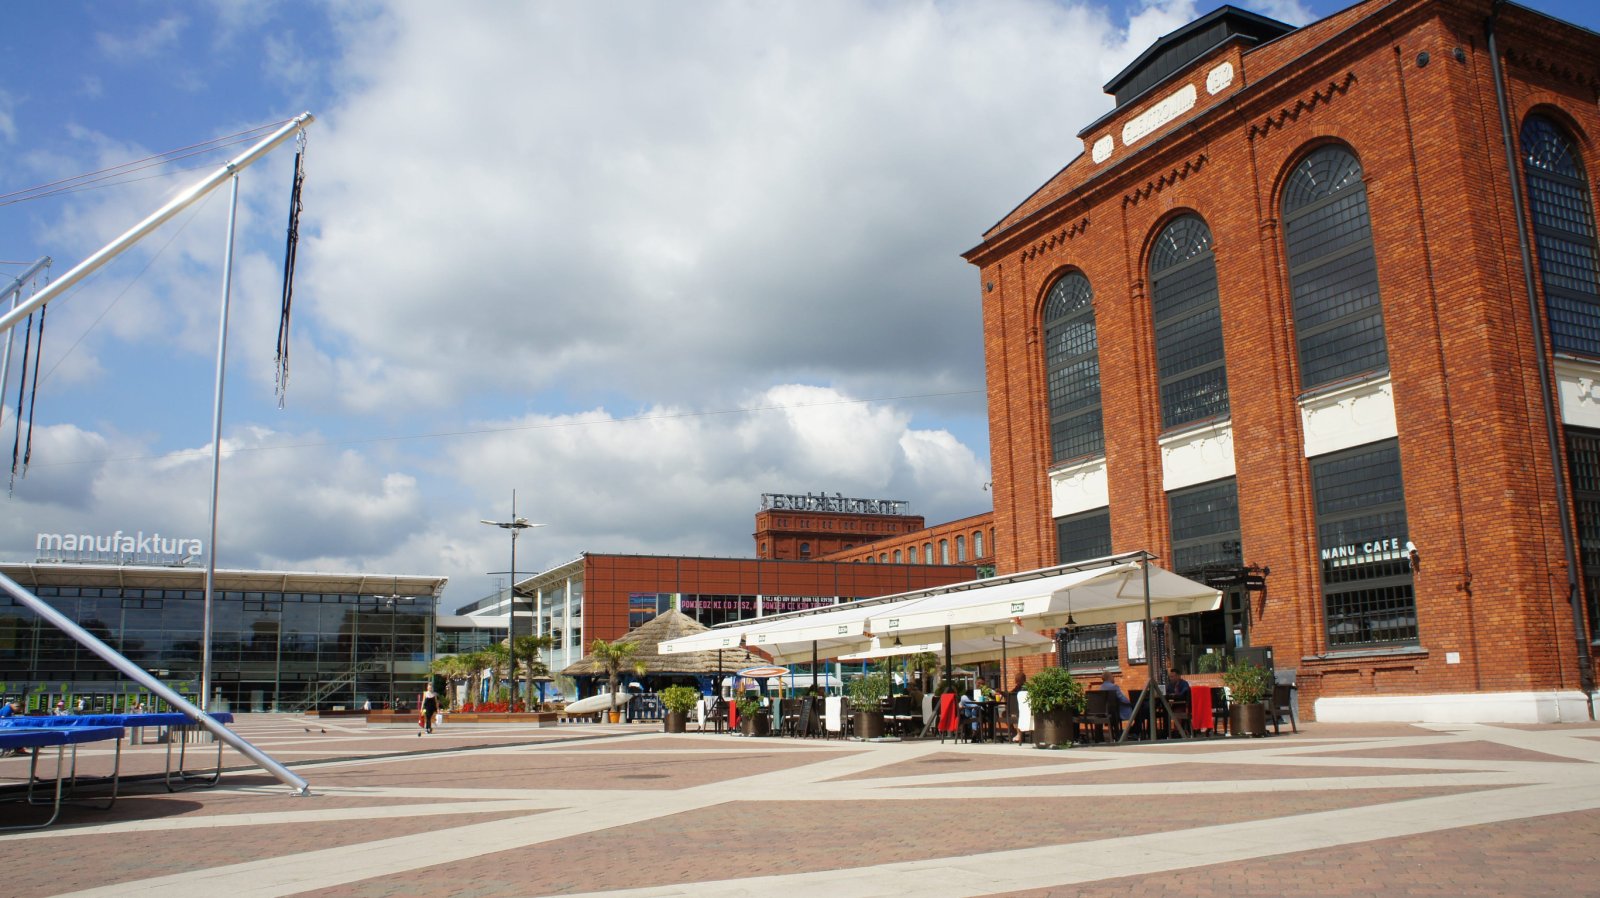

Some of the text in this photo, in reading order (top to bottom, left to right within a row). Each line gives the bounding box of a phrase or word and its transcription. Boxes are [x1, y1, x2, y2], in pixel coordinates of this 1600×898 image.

[36, 530, 203, 555] manufaktura
[1321, 538, 1399, 559] MANU CAFE
